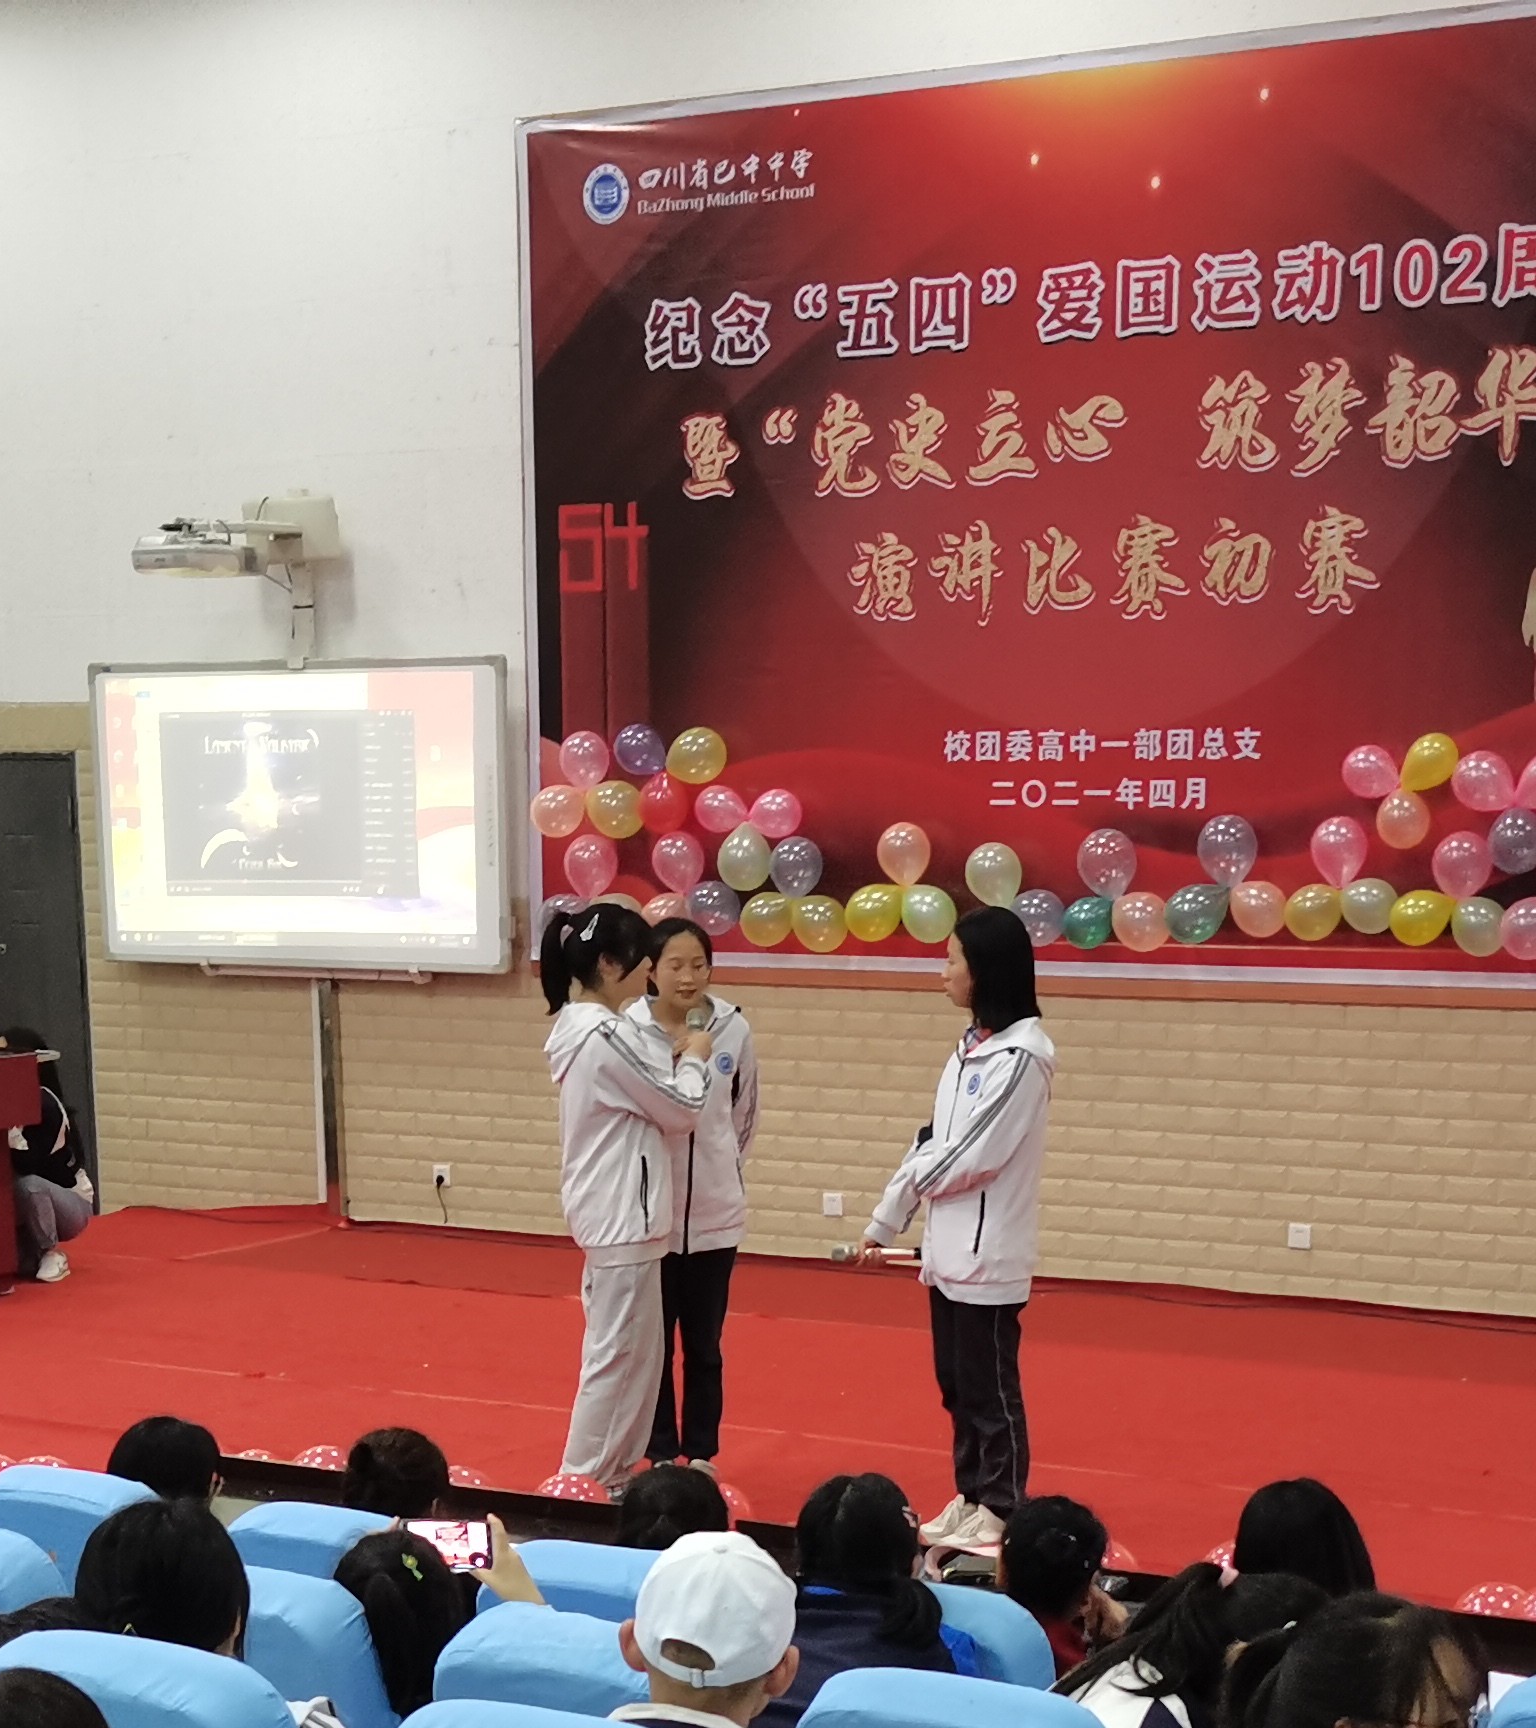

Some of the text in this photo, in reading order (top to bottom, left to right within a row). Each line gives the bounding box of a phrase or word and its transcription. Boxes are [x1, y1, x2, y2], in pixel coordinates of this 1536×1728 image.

[637, 148, 813, 190] 四川省巴中中学
[706, 189, 759, 207] Middle
[761, 183, 815, 202] School
[847, 504, 1380, 626] 演讲比赛初赛
[944, 727, 1262, 762] 校团委高中一部团总支
